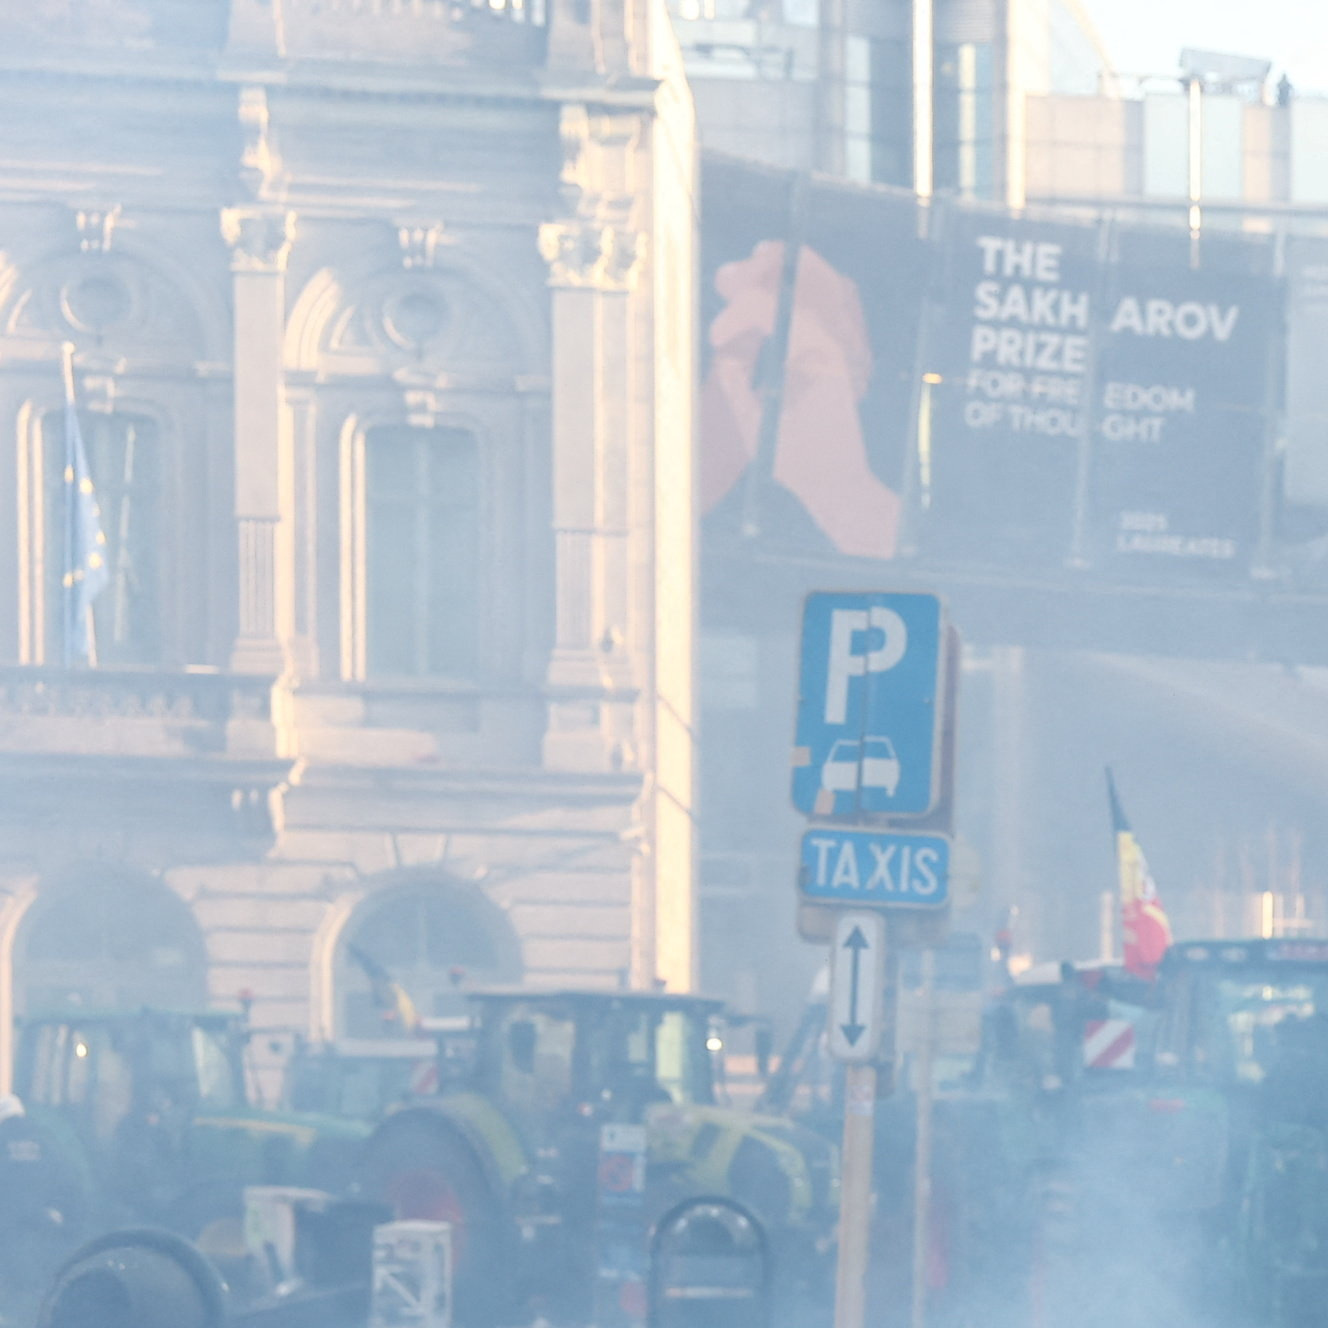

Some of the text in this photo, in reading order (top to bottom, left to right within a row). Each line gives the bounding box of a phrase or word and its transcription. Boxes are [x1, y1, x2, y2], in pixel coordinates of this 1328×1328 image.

[976, 235, 1062, 281] THE
[974, 281, 1239, 341] SAKH AROV
[970, 325, 1088, 372] PRIZE
[966, 368, 1026, 399] FOR
[965, 401, 1001, 428] OF
[824, 605, 908, 725] P
[811, 838, 939, 896] TAXIS
